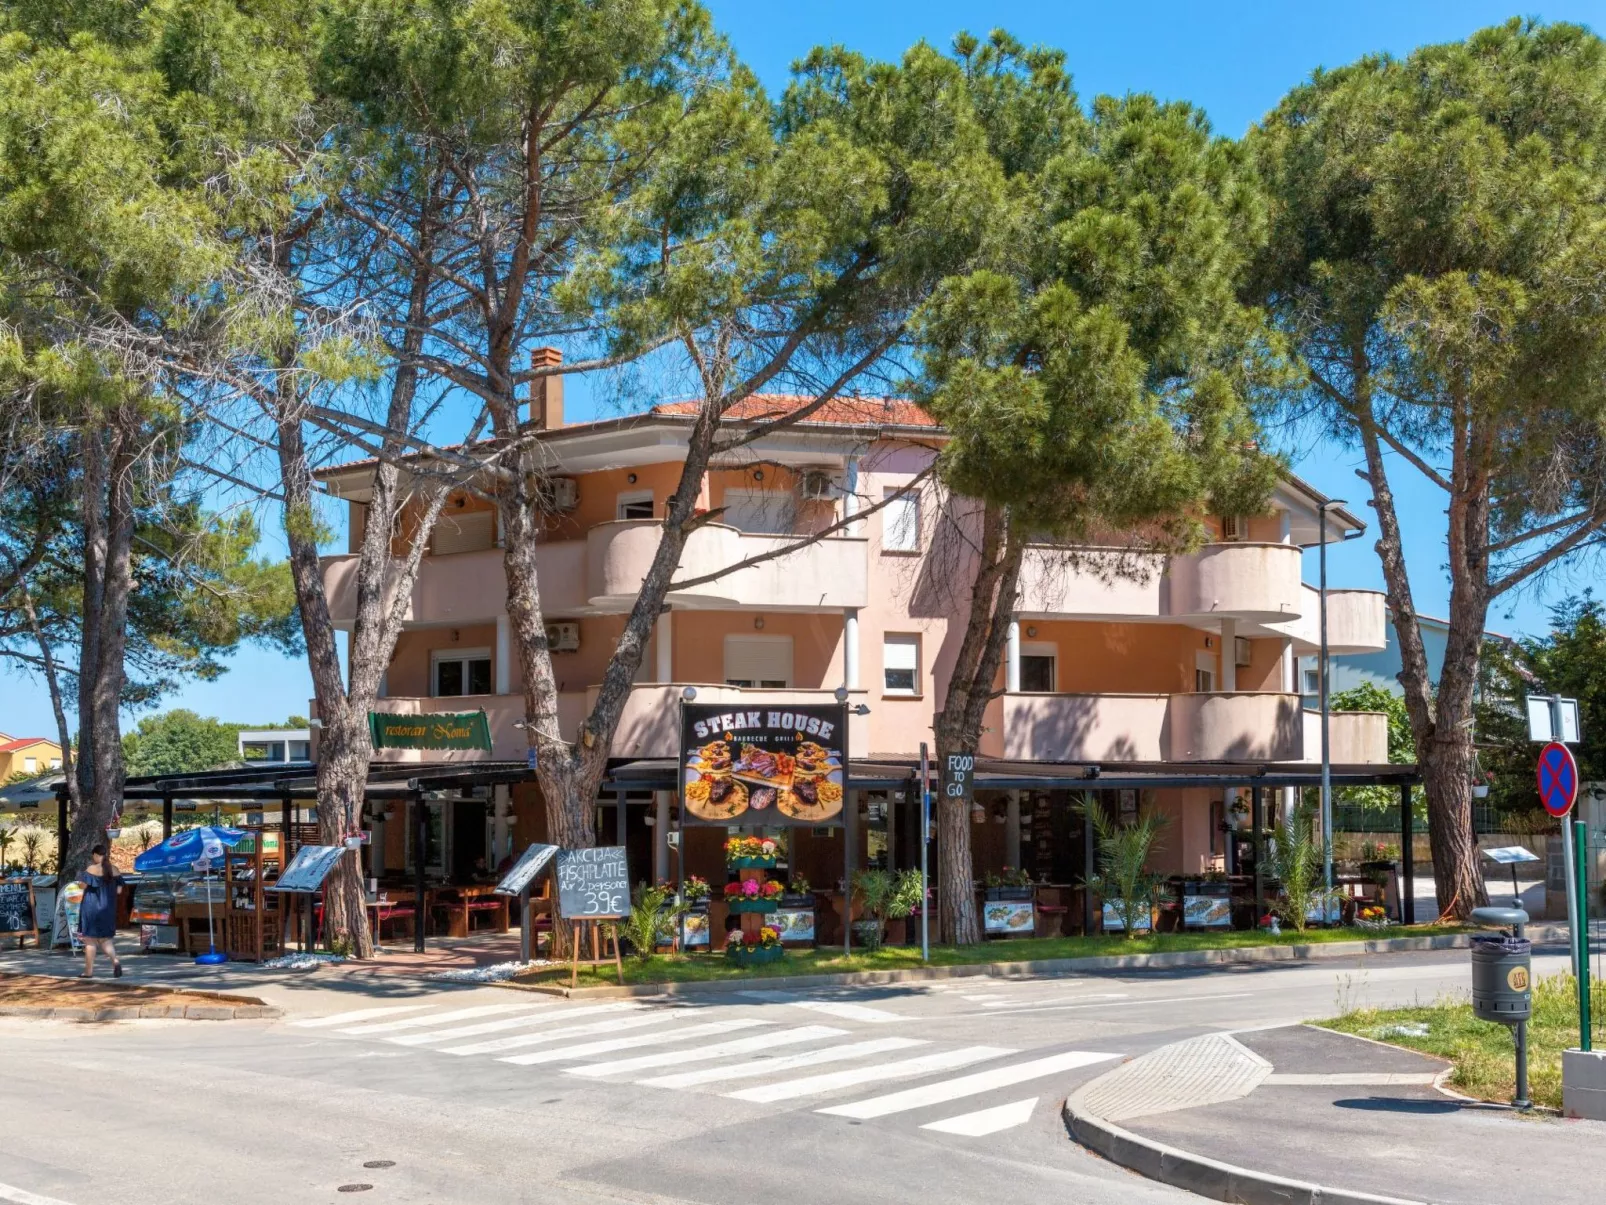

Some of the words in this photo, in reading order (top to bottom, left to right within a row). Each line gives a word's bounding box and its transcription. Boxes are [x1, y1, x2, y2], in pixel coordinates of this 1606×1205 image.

[385, 725, 427, 737] restoran
[694, 711, 761, 738] STEAK
[767, 711, 835, 740] HOUSE
[948, 755, 973, 771] FOOD
[954, 771, 965, 782] TO
[947, 782, 963, 797] GO
[558, 861, 627, 880] FISCHPLATTE
[577, 879, 586, 892] 2
[583, 891, 622, 914] 39€
